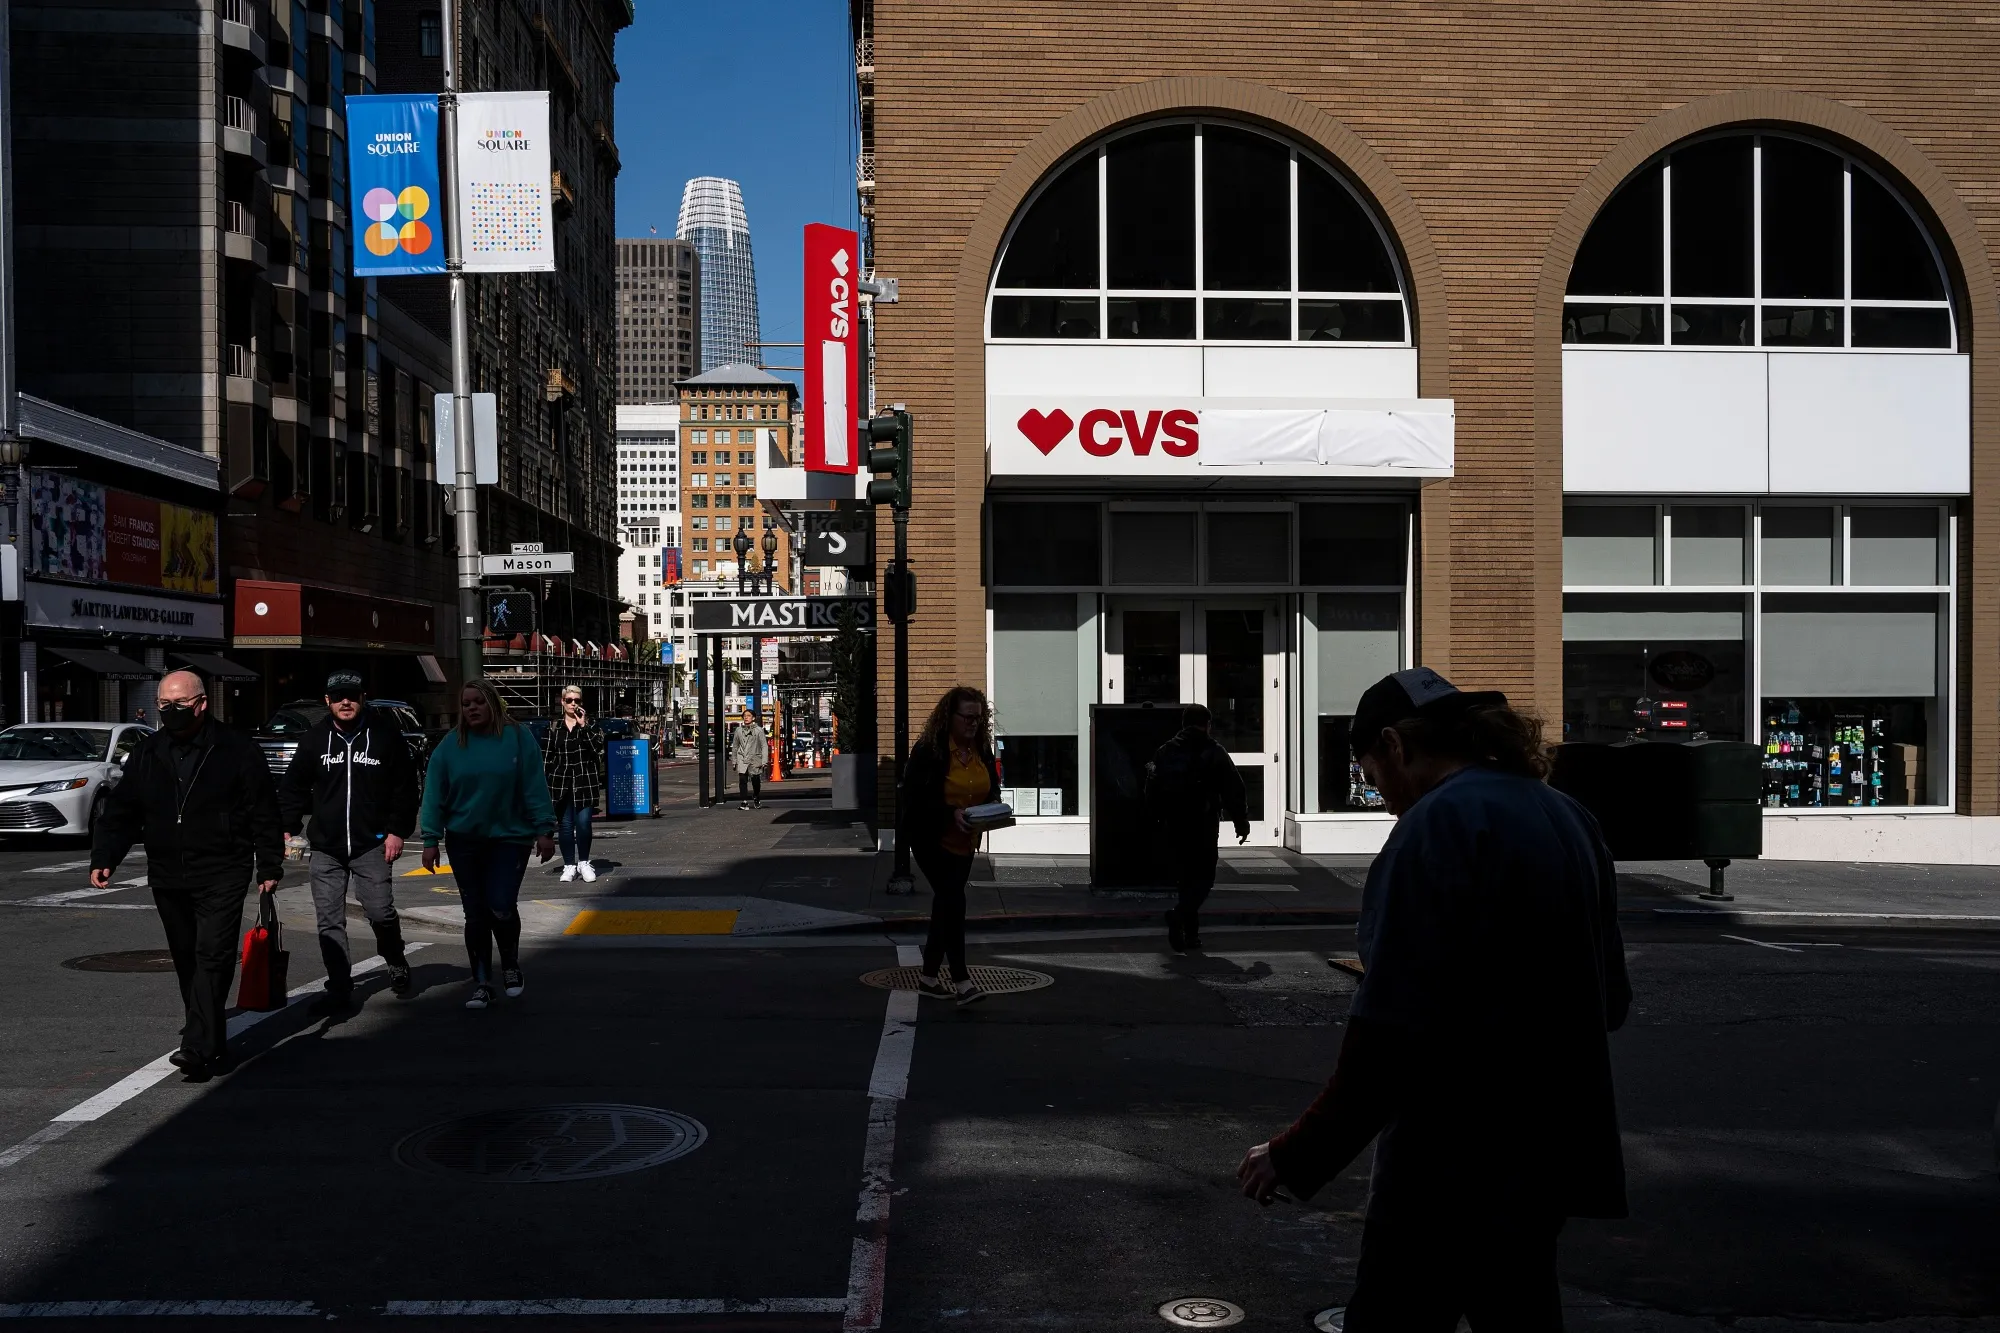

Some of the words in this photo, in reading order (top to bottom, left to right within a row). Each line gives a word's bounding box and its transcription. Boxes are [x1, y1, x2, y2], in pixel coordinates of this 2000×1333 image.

[375, 132, 412, 142] UNION
[485, 130, 522, 139] UNION
[367, 141, 421, 157] SQUARE
[477, 139, 532, 153] SQUARE
[830, 277, 849, 339] CVS
[1078, 408, 1199, 457] CVS
[113, 514, 127, 529] SAM
[128, 517, 155, 534] FRANCIS
[107, 530, 131, 545] ROBERT
[131, 535, 160, 551] STANDISH
[503, 558, 552, 570] Mason
[320, 750, 345, 766] Trail
[352, 751, 381, 767] blazer
